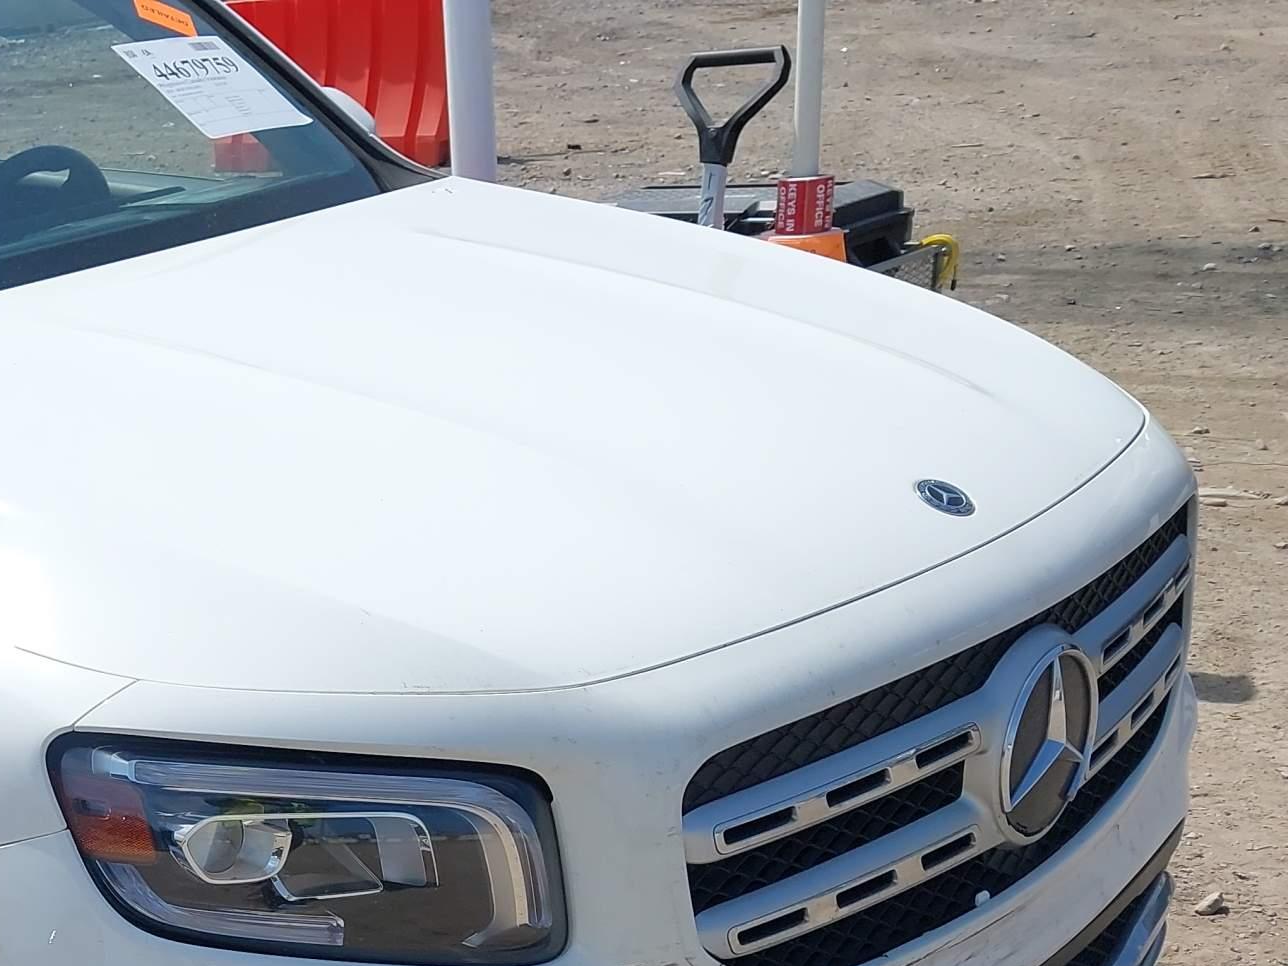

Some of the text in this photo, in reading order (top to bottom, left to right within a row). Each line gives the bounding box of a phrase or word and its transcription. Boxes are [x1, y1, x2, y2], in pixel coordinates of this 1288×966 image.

[152, 56, 239, 80] 44679759
[778, 187, 786, 228] OFFICE
[786, 183, 797, 232] KEYS IN
[814, 184, 825, 228] OFFICE
